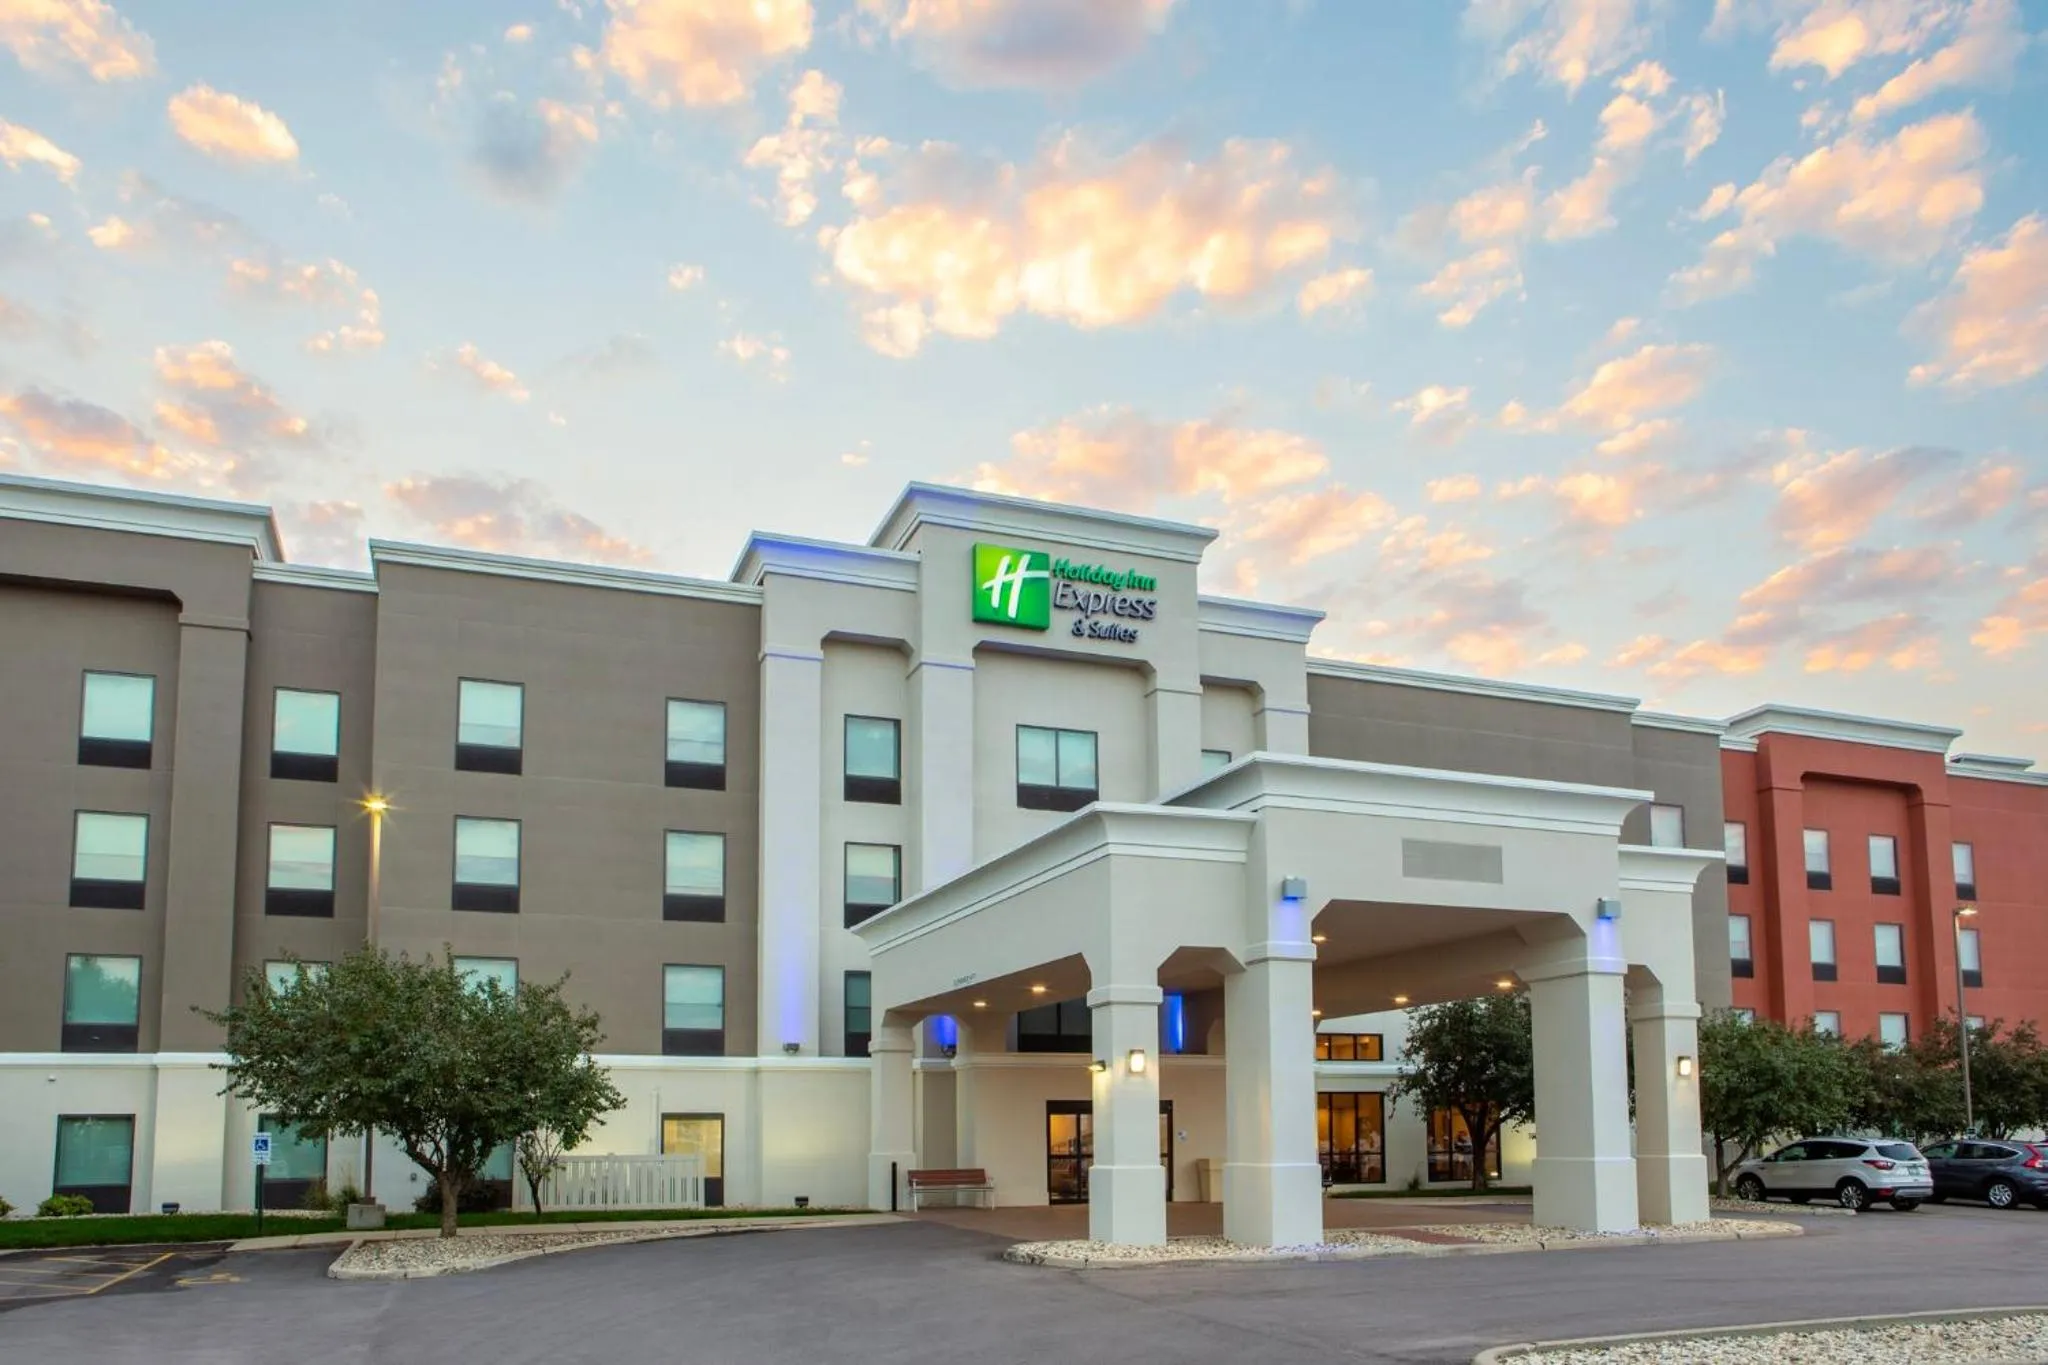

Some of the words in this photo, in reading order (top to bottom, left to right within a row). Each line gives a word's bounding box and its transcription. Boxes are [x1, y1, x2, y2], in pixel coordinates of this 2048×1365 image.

[1052, 559, 1126, 591] Holiday
[1127, 568, 1157, 591] Inn
[1054, 580, 1157, 620] Express
[1072, 619, 1085, 636] &
[1088, 620, 1139, 643] Suites
